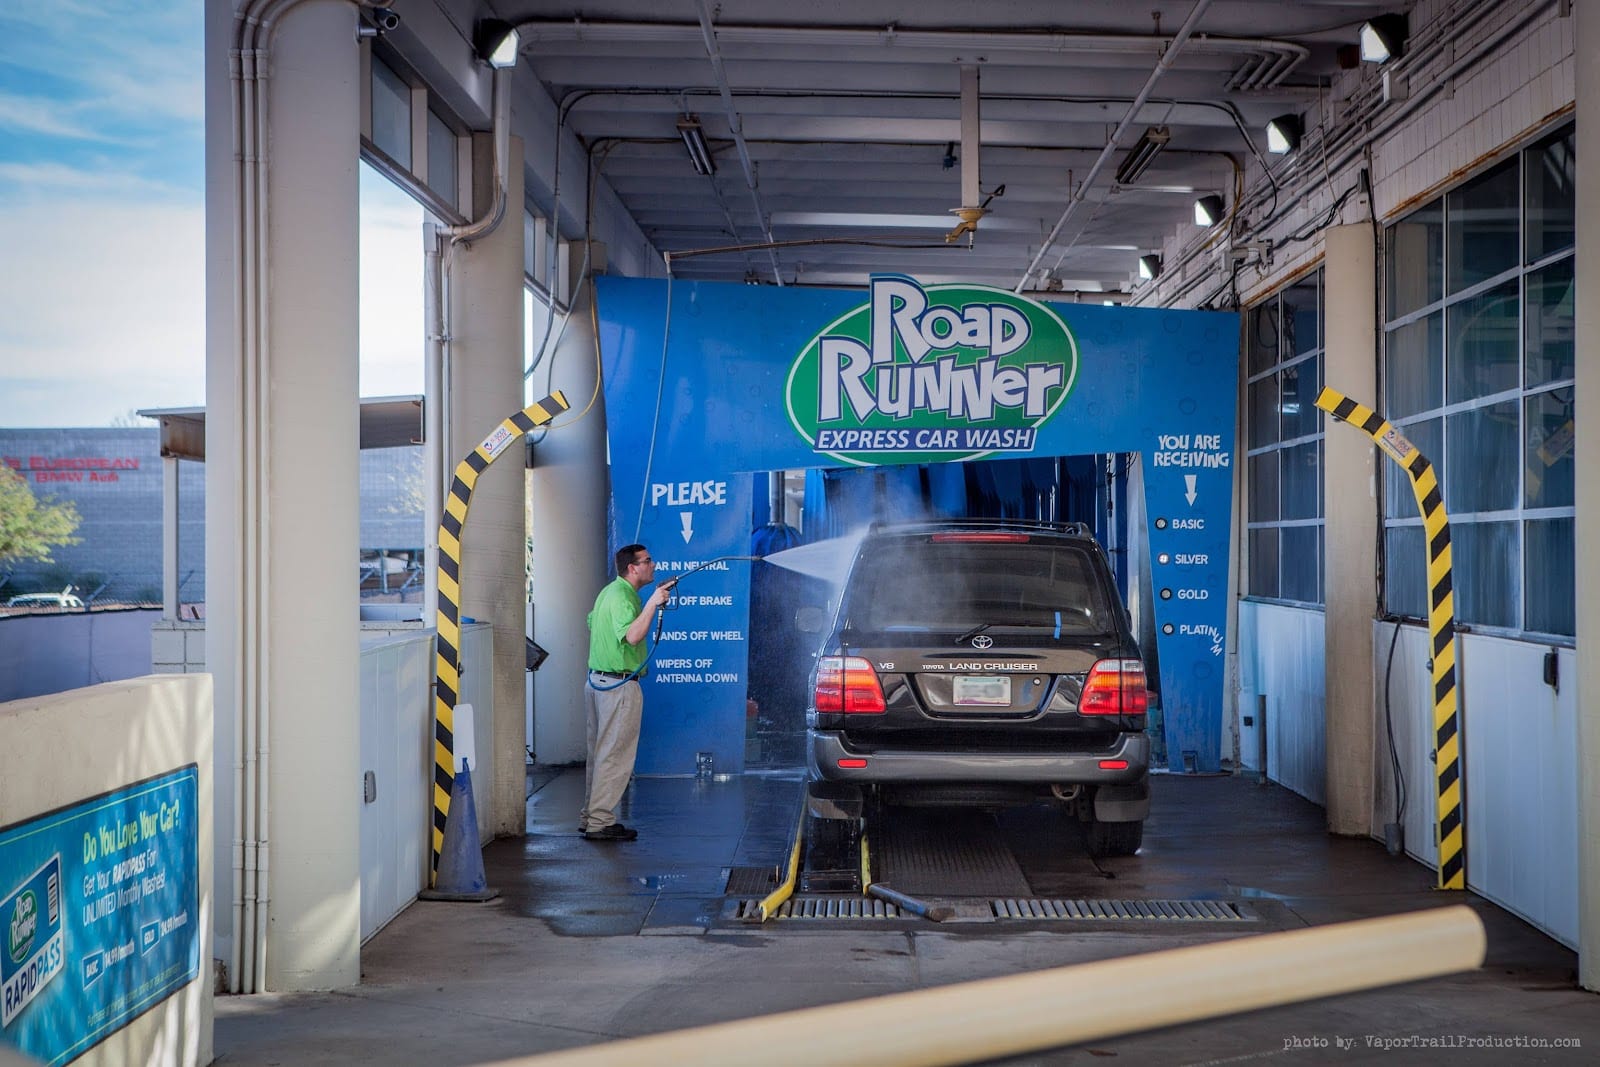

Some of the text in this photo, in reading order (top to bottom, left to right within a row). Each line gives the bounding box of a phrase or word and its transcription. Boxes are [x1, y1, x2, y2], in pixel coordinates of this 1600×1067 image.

[818, 429, 1032, 449] EXPRESS CAR WASH
[1158, 435, 1220, 450] YOU ARE
[1153, 452, 1229, 468] RECEIVING
[36, 471, 83, 483] BMW
[652, 480, 727, 506] PLEASE
[1172, 519, 1205, 529] BASIC
[1175, 554, 1208, 565] SILVER
[655, 561, 670, 571] AR
[671, 561, 682, 571] IN
[1177, 589, 1208, 600] GOLD
[679, 596, 698, 606] OFF
[700, 596, 733, 606] BRAKE
[690, 631, 709, 641] OFF
[711, 631, 744, 641] WHEEL
[1179, 624, 1223, 656] PLATINUM
[655, 659, 713, 669] WIPERS OFF
[879, 662, 895, 670] V8
[984, 663, 1038, 671] CRUISER
[655, 673, 738, 683] ANTENNA DOWN
[83, 799, 179, 865] Do You Love Your Car?
[83, 875, 95, 898] Get
[97, 870, 111, 891] Your
[5, 936, 61, 1017] RAPIDPASS
